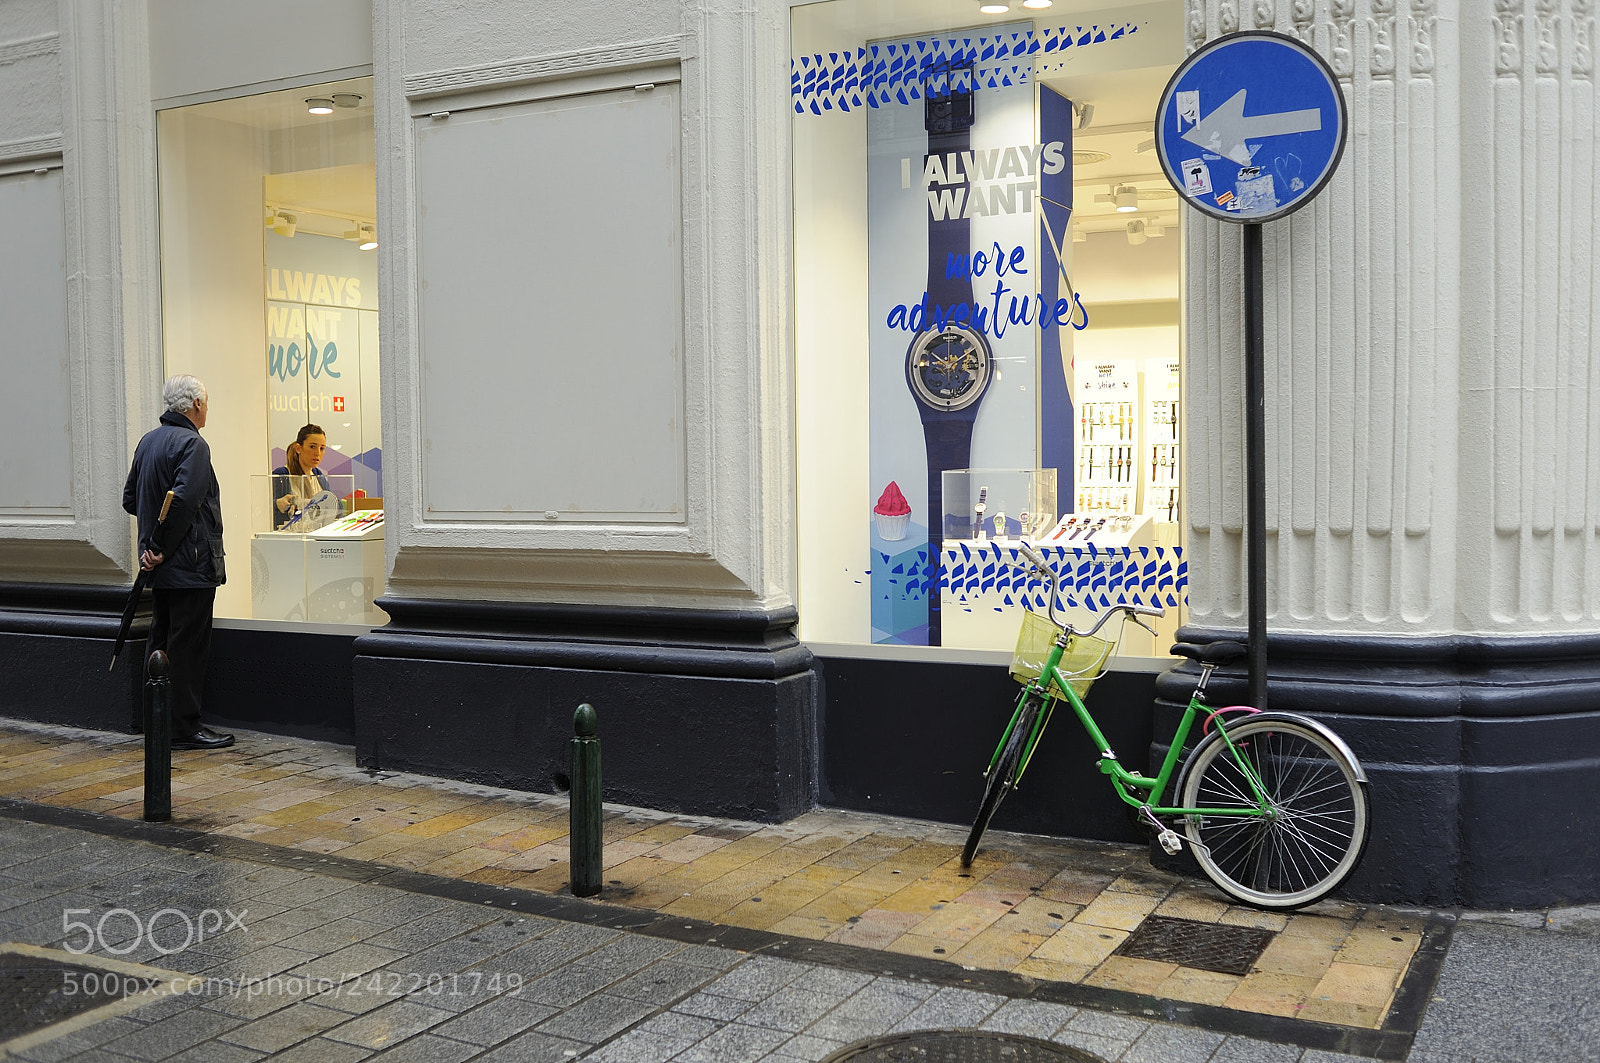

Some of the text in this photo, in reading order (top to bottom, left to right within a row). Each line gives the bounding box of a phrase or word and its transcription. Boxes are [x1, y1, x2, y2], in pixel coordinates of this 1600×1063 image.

[901, 141, 1066, 189] I ALWAYS
[927, 181, 1037, 222] WANT
[946, 241, 1028, 283] more
[267, 268, 362, 307] LWAYS
[887, 279, 1089, 340] adventures
